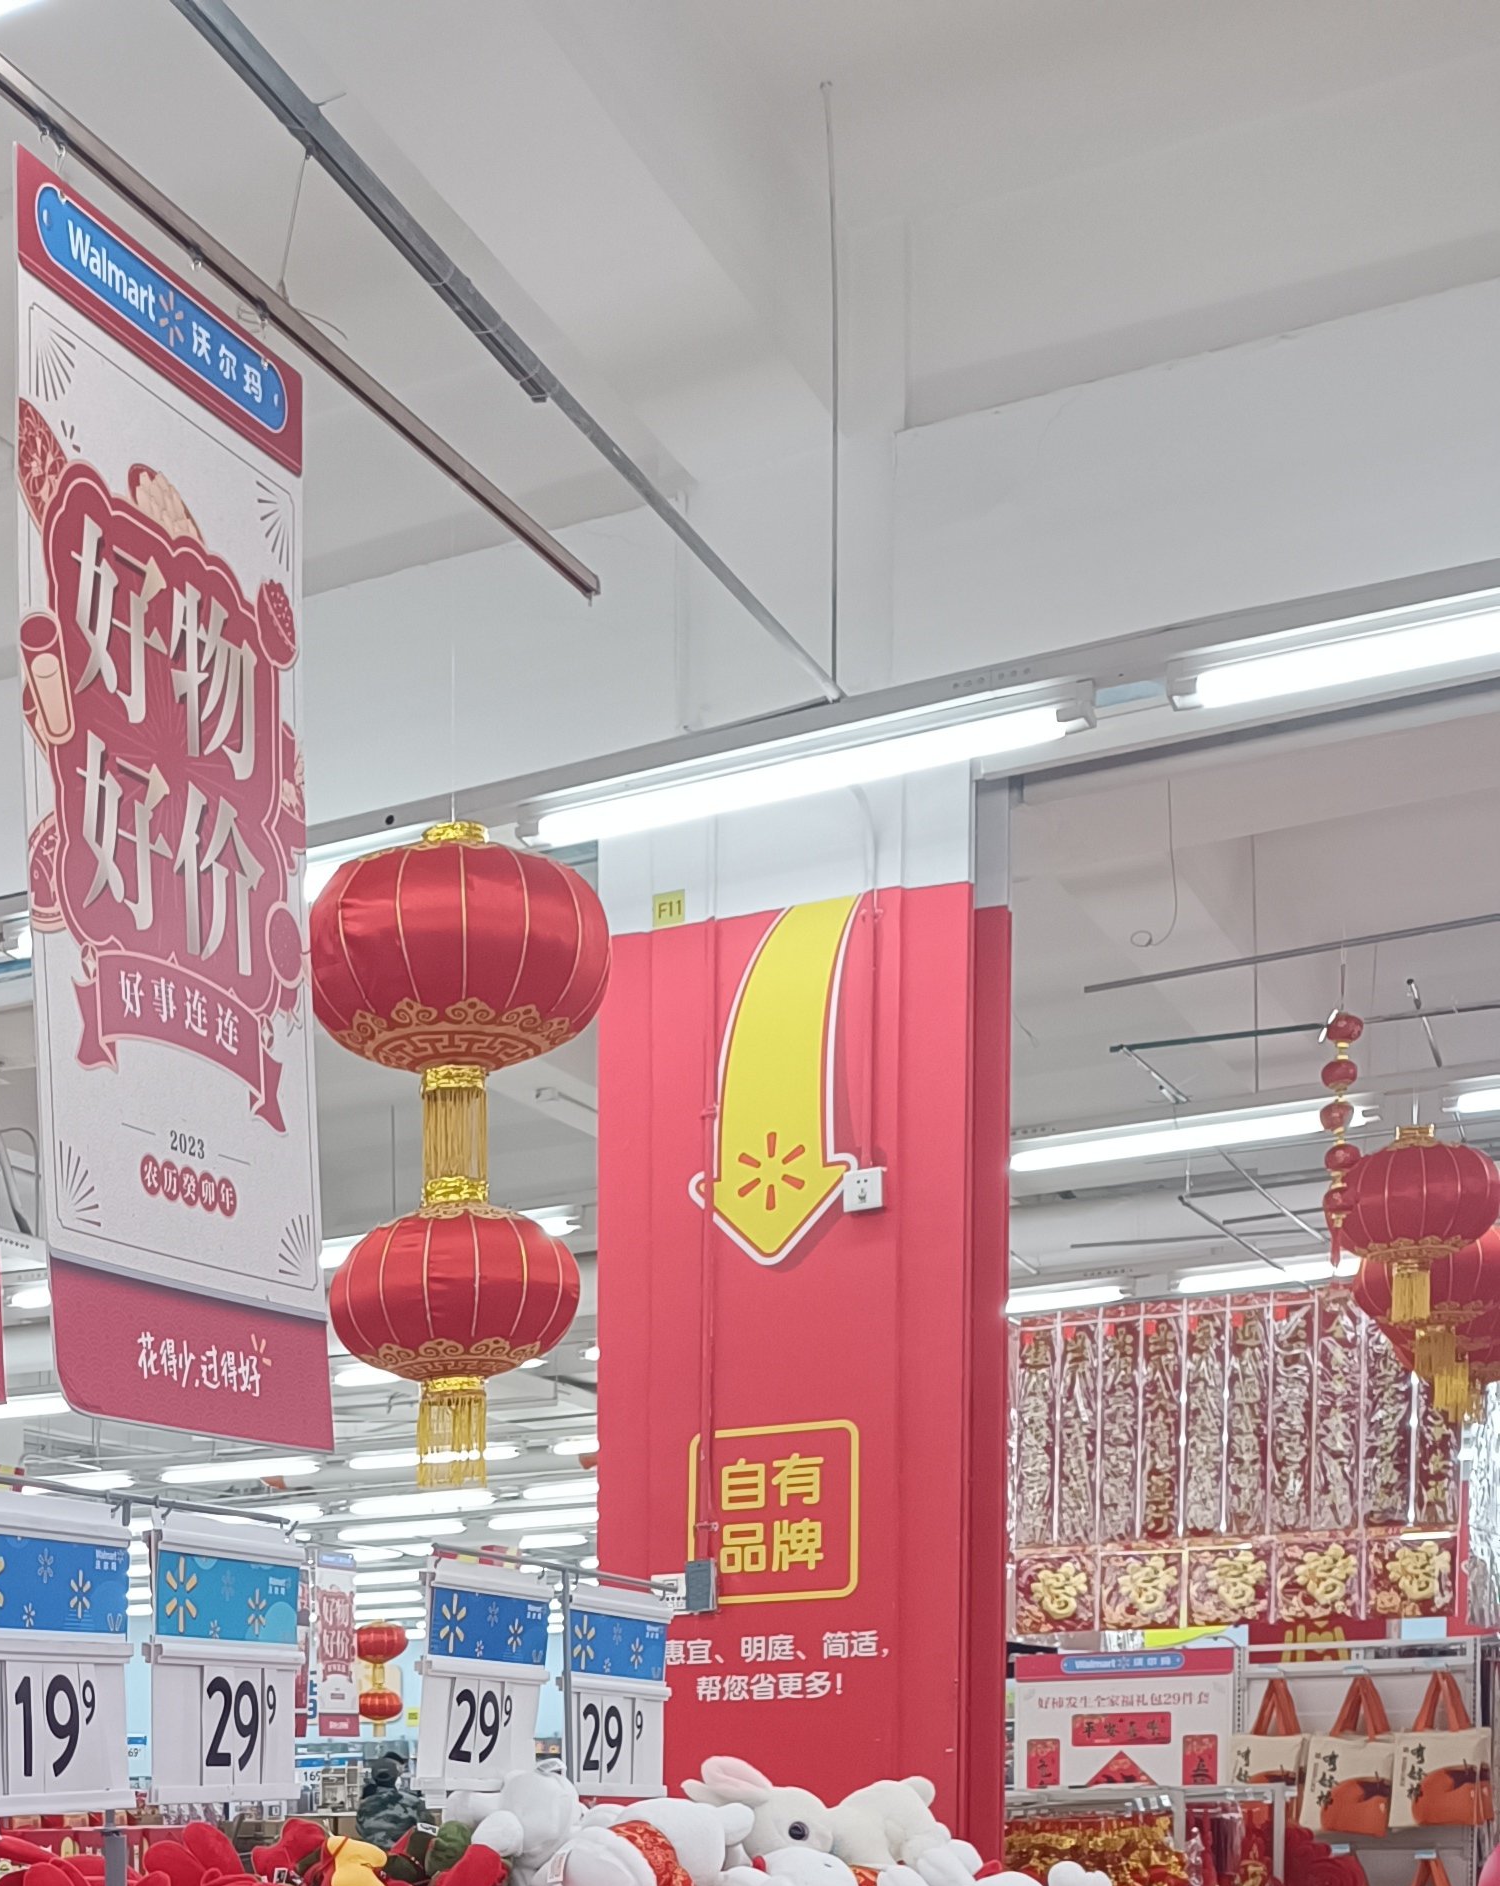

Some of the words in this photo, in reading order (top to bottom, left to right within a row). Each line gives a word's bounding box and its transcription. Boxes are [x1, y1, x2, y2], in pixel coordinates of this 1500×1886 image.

[67, 218, 157, 322] Walmart
[191, 319, 266, 406] 沃尔玛
[70, 512, 258, 781] 好物
[75, 731, 266, 976] 好价
[658, 899, 683, 920] F11
[118, 968, 241, 1058] 好事连连
[169, 1129, 205, 1160] 2023
[143, 1160, 237, 1212] 农历癸卯年
[721, 1453, 824, 1511] 自有
[719, 1519, 825, 1574] 品牌
